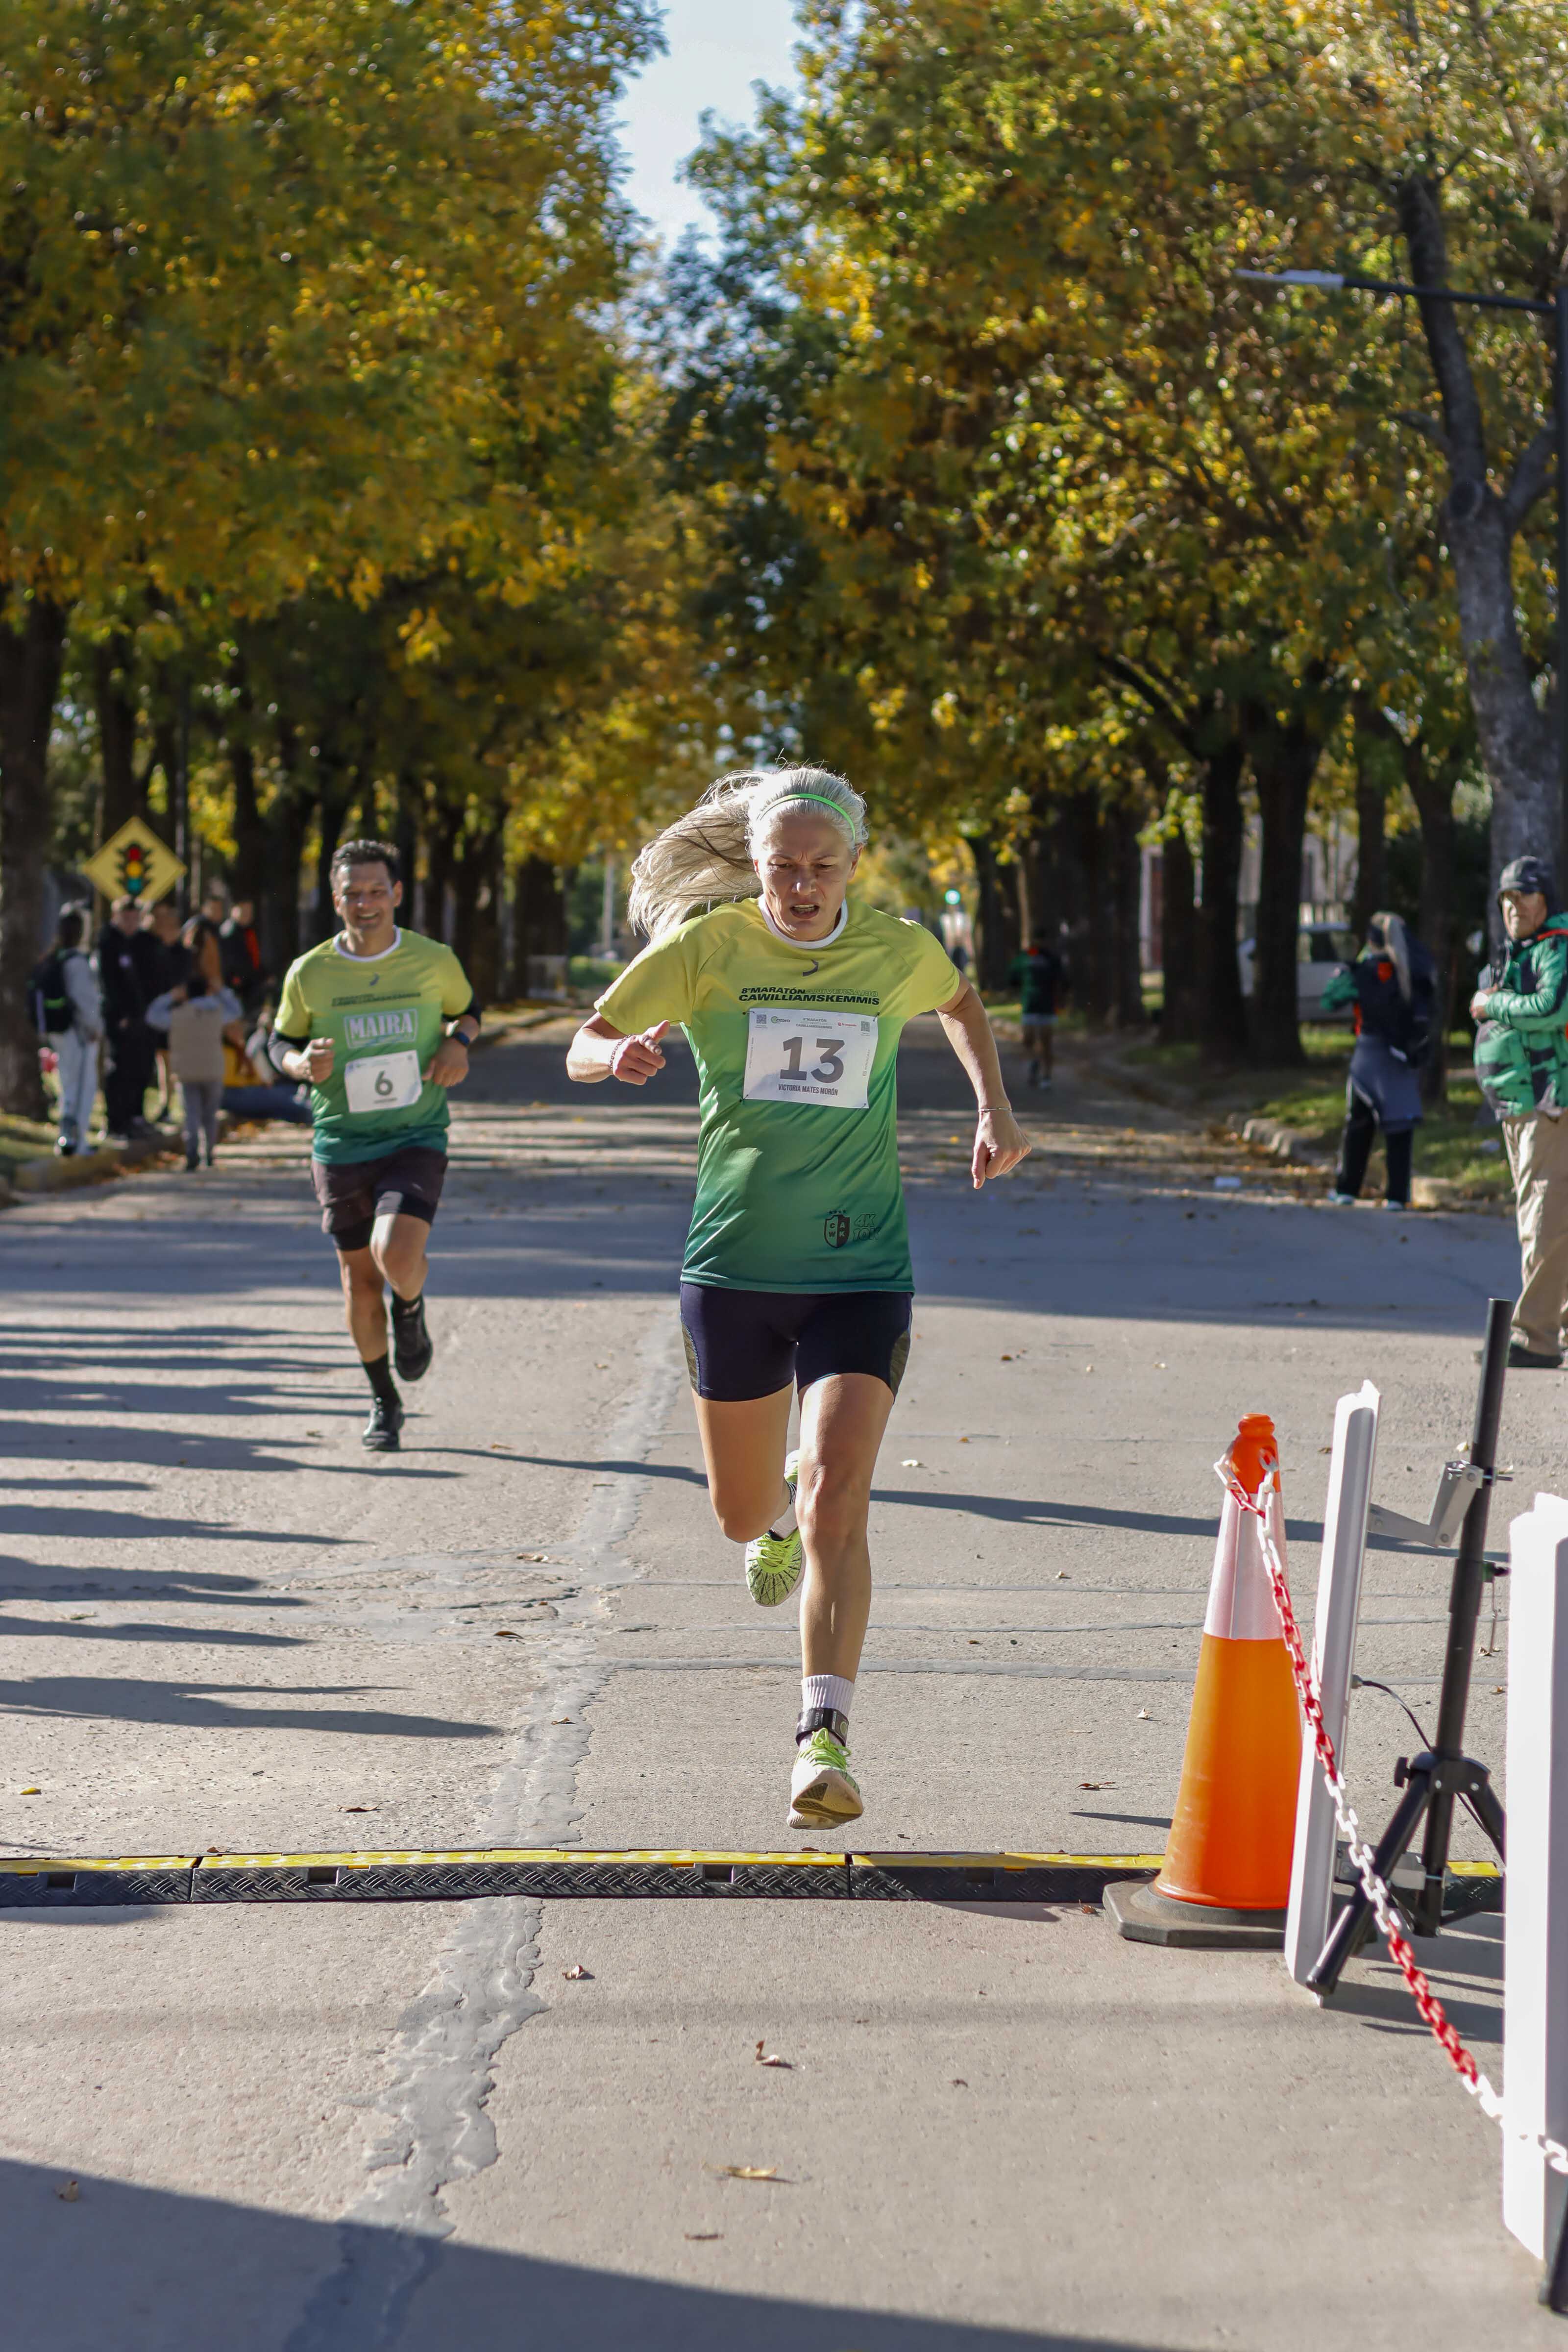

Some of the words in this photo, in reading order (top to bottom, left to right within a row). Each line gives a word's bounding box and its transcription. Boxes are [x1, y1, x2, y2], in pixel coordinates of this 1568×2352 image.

[738, 993, 880, 1005] CAWILLIAMSKEMMIS
[349, 1012, 413, 1038] MAIRA
[780, 1036, 845, 1083] 13
[375, 1070, 393, 1096] 6
[778, 1084, 801, 1092] VICTORIA
[802, 1085, 819, 1094] MATES
[820, 1087, 838, 1096] MORÓN
[854, 1214, 876, 1227] 4K
